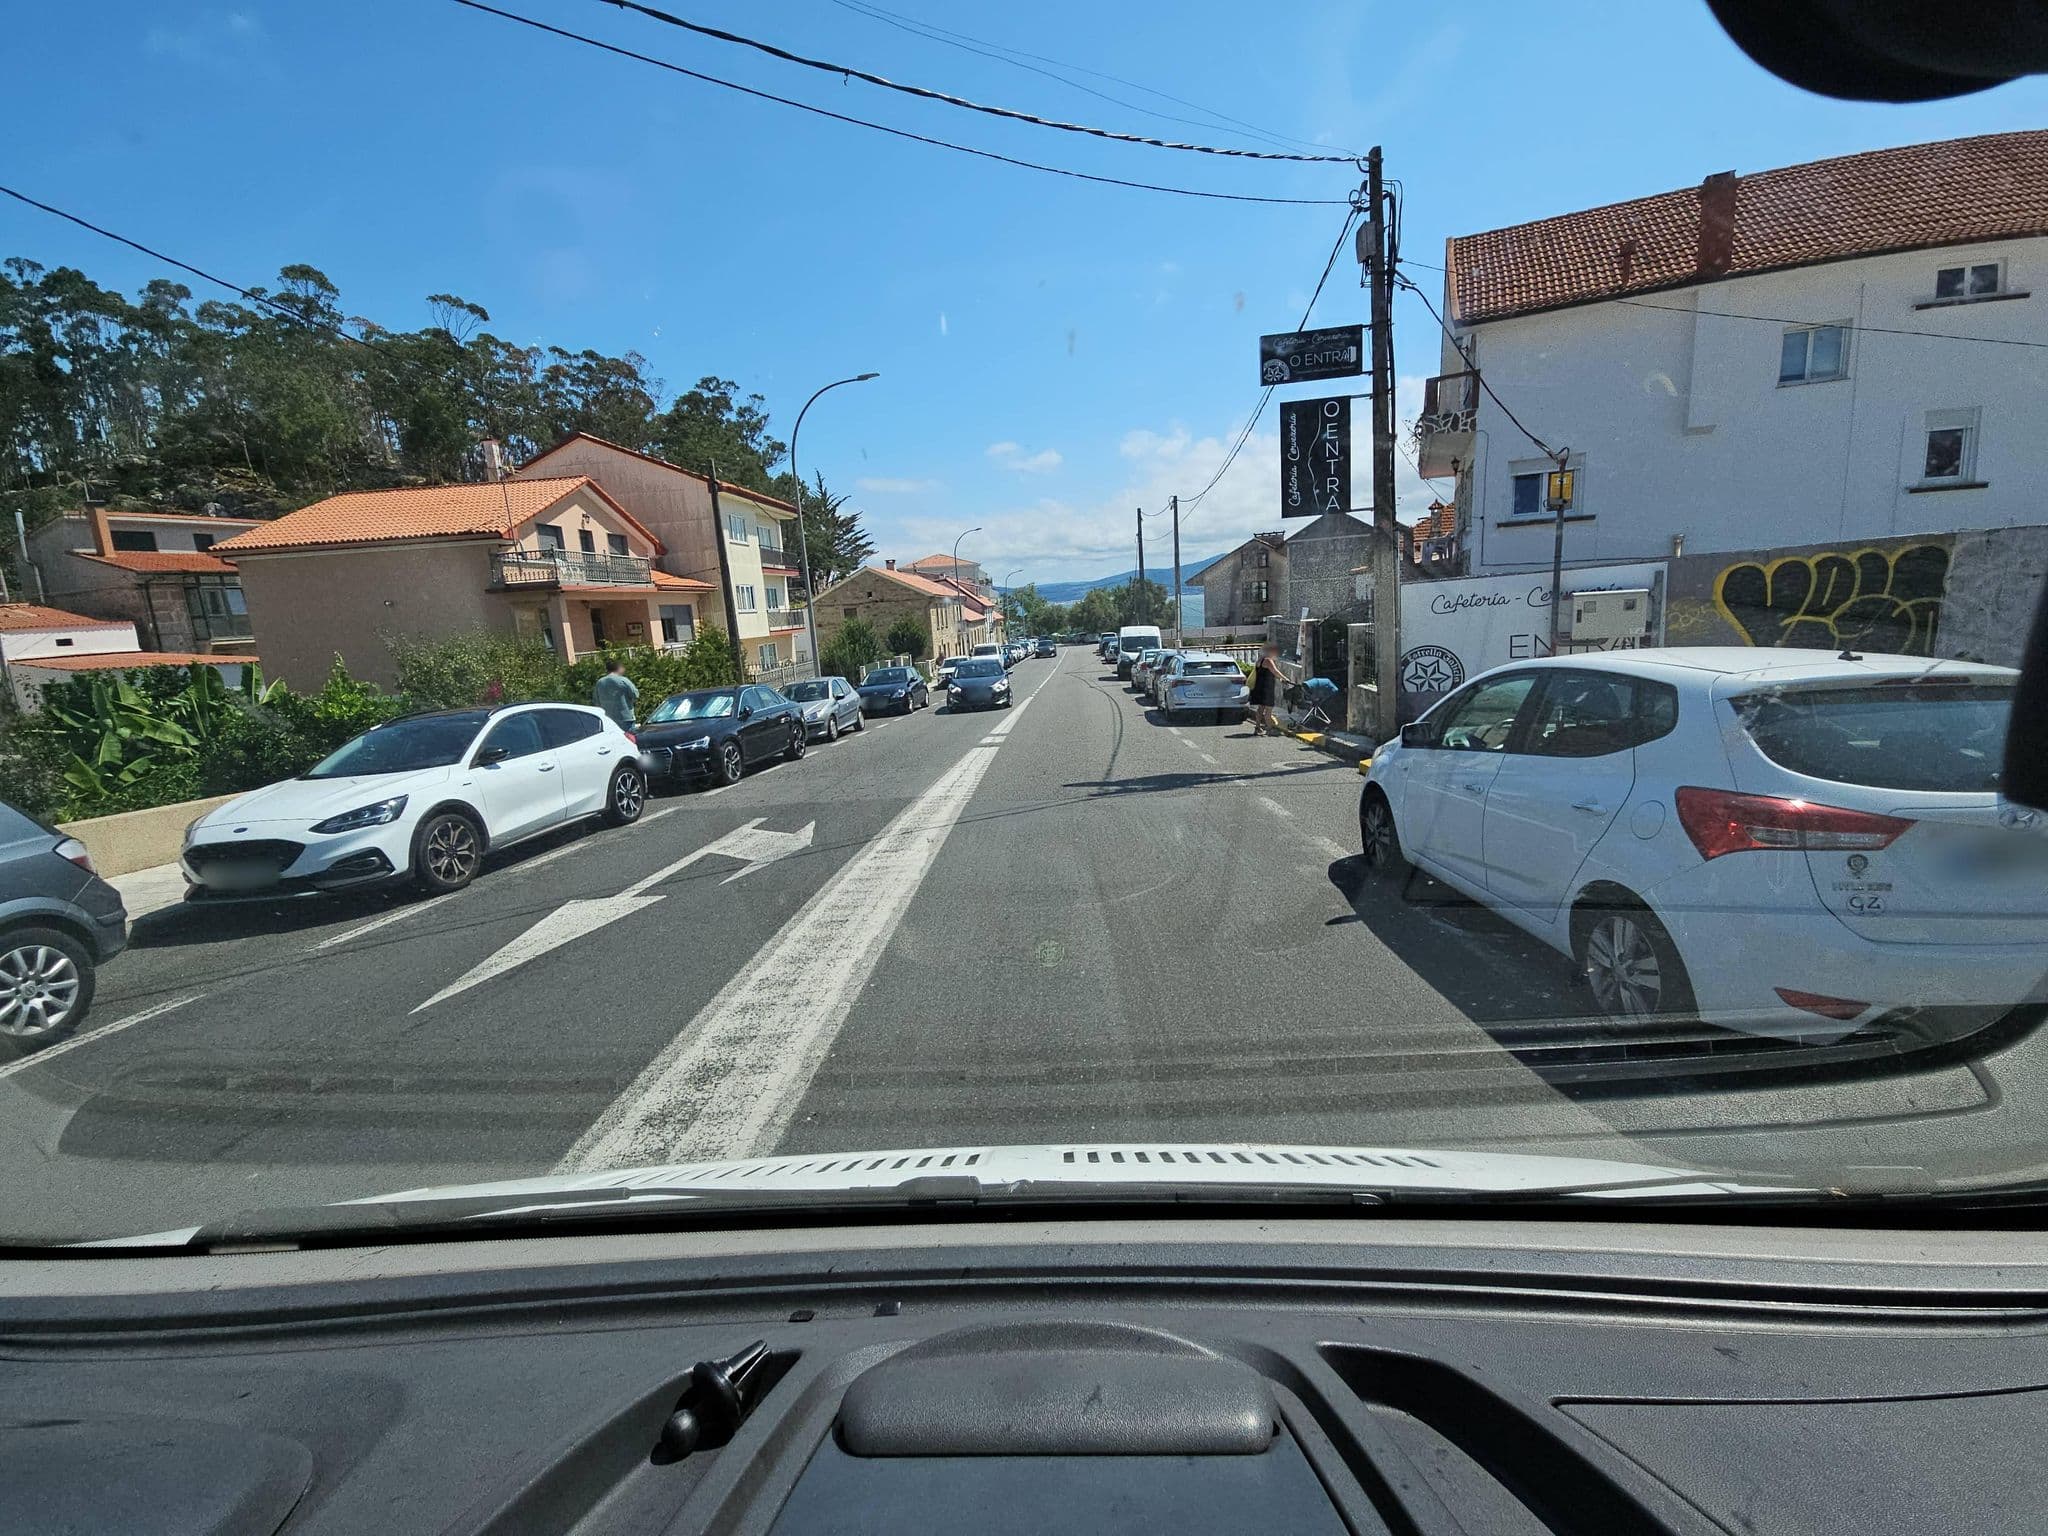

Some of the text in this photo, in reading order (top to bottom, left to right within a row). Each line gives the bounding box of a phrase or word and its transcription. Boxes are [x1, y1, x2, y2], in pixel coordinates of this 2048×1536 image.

[1289, 355, 1301, 367] O
[1324, 401, 1341, 511] O ENTRA
[1430, 592, 1511, 614] Cafetería
[1407, 648, 1442, 662] Estrella
